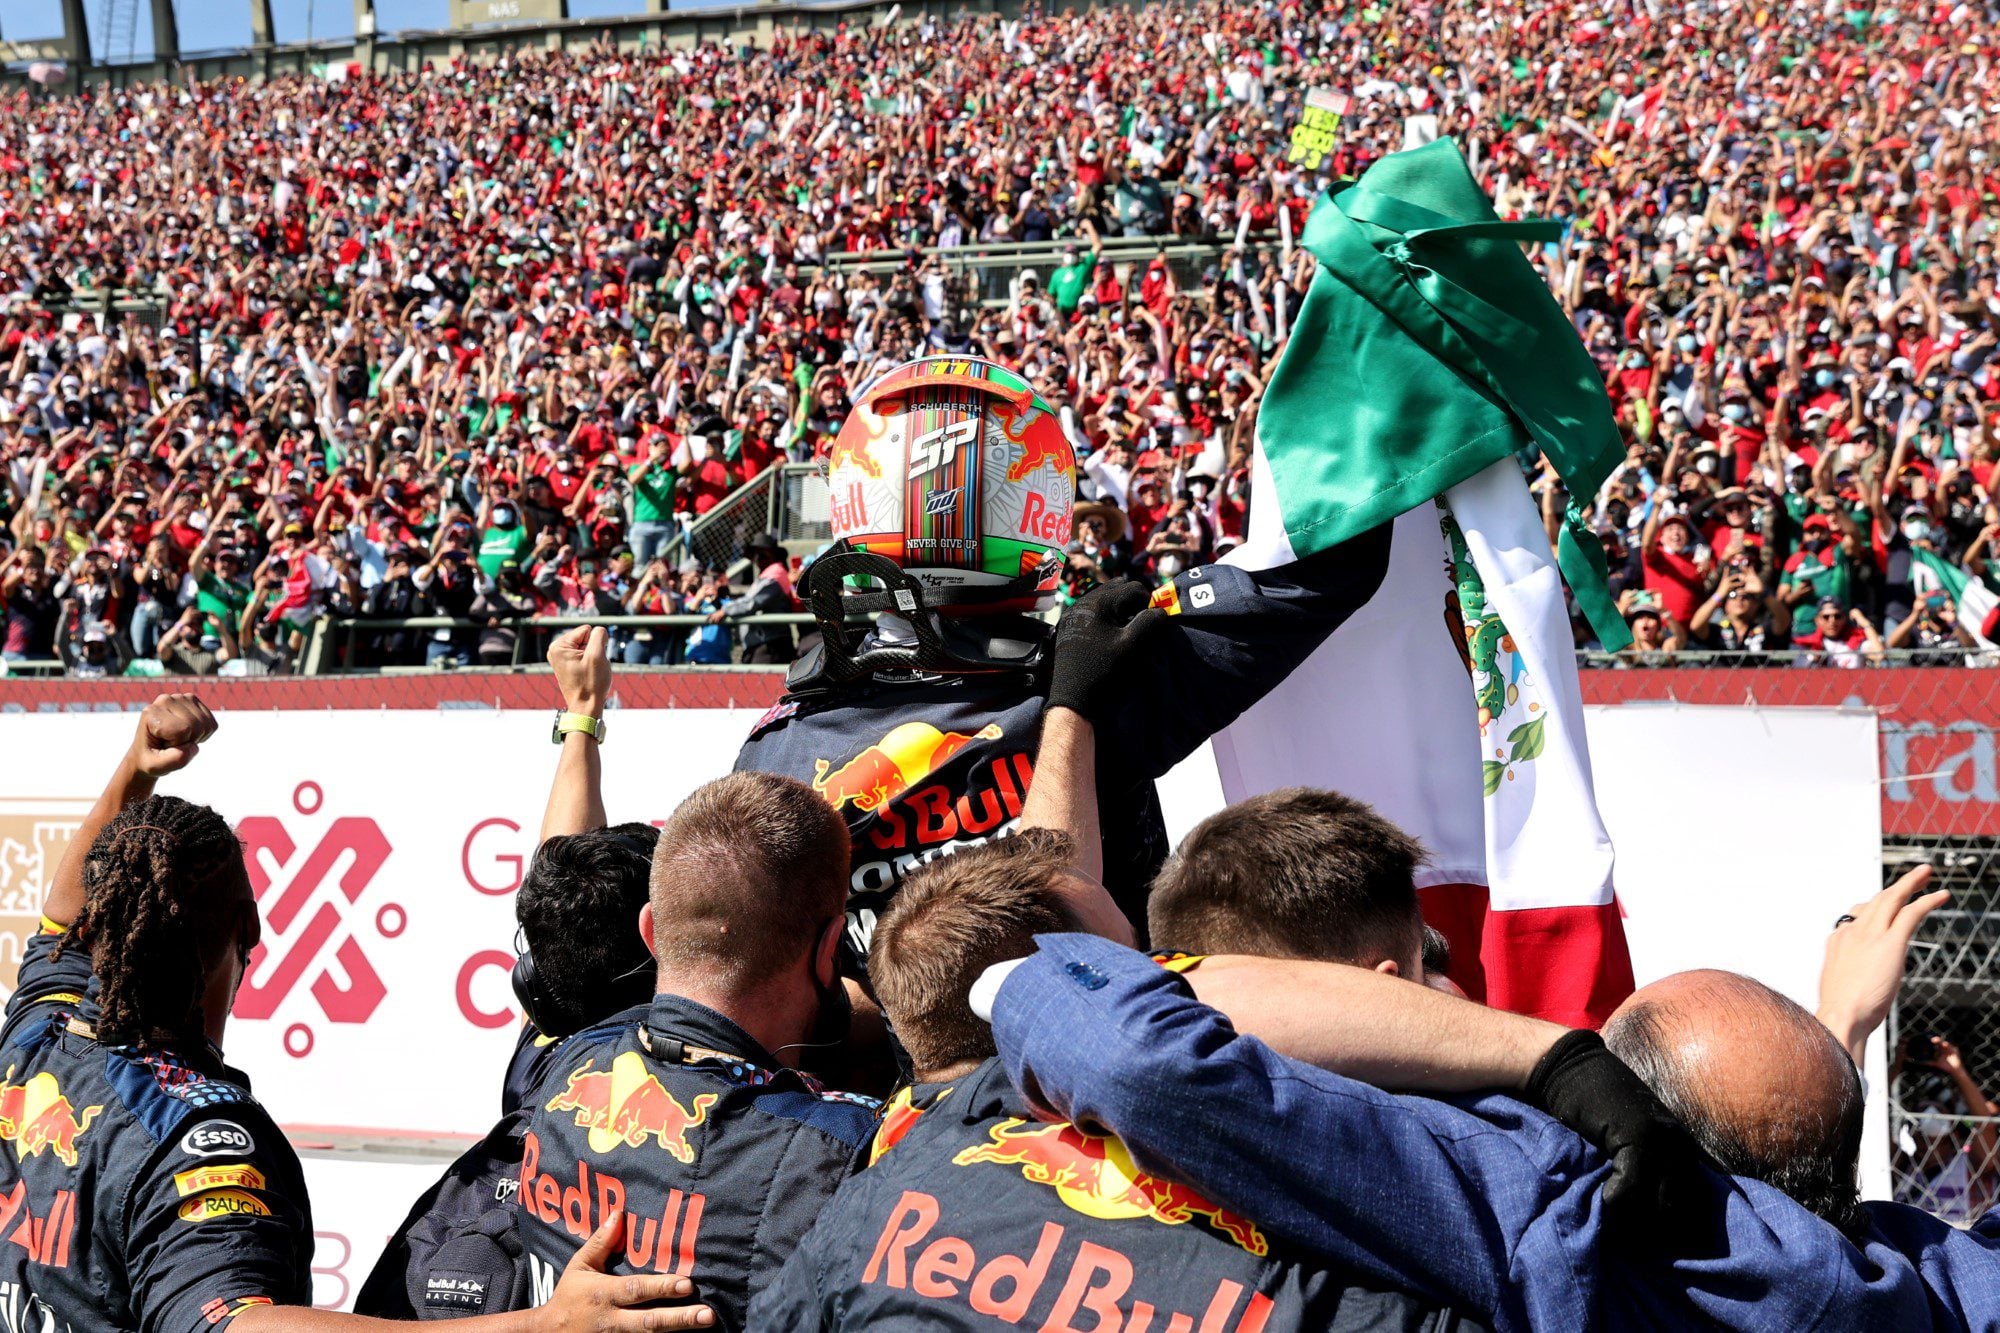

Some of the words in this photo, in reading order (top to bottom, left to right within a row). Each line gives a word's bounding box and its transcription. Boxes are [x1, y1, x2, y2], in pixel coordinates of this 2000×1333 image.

[910, 402, 983, 413] SCHUBERTH
[906, 538, 937, 549] NEVER
[940, 539, 962, 549] GIVE
[964, 539, 978, 549] UP
[518, 1131, 592, 1241] Red
[205, 1197, 262, 1216] RAUCH
[862, 1190, 1064, 1323] Red
[426, 1293, 482, 1304] RACING
